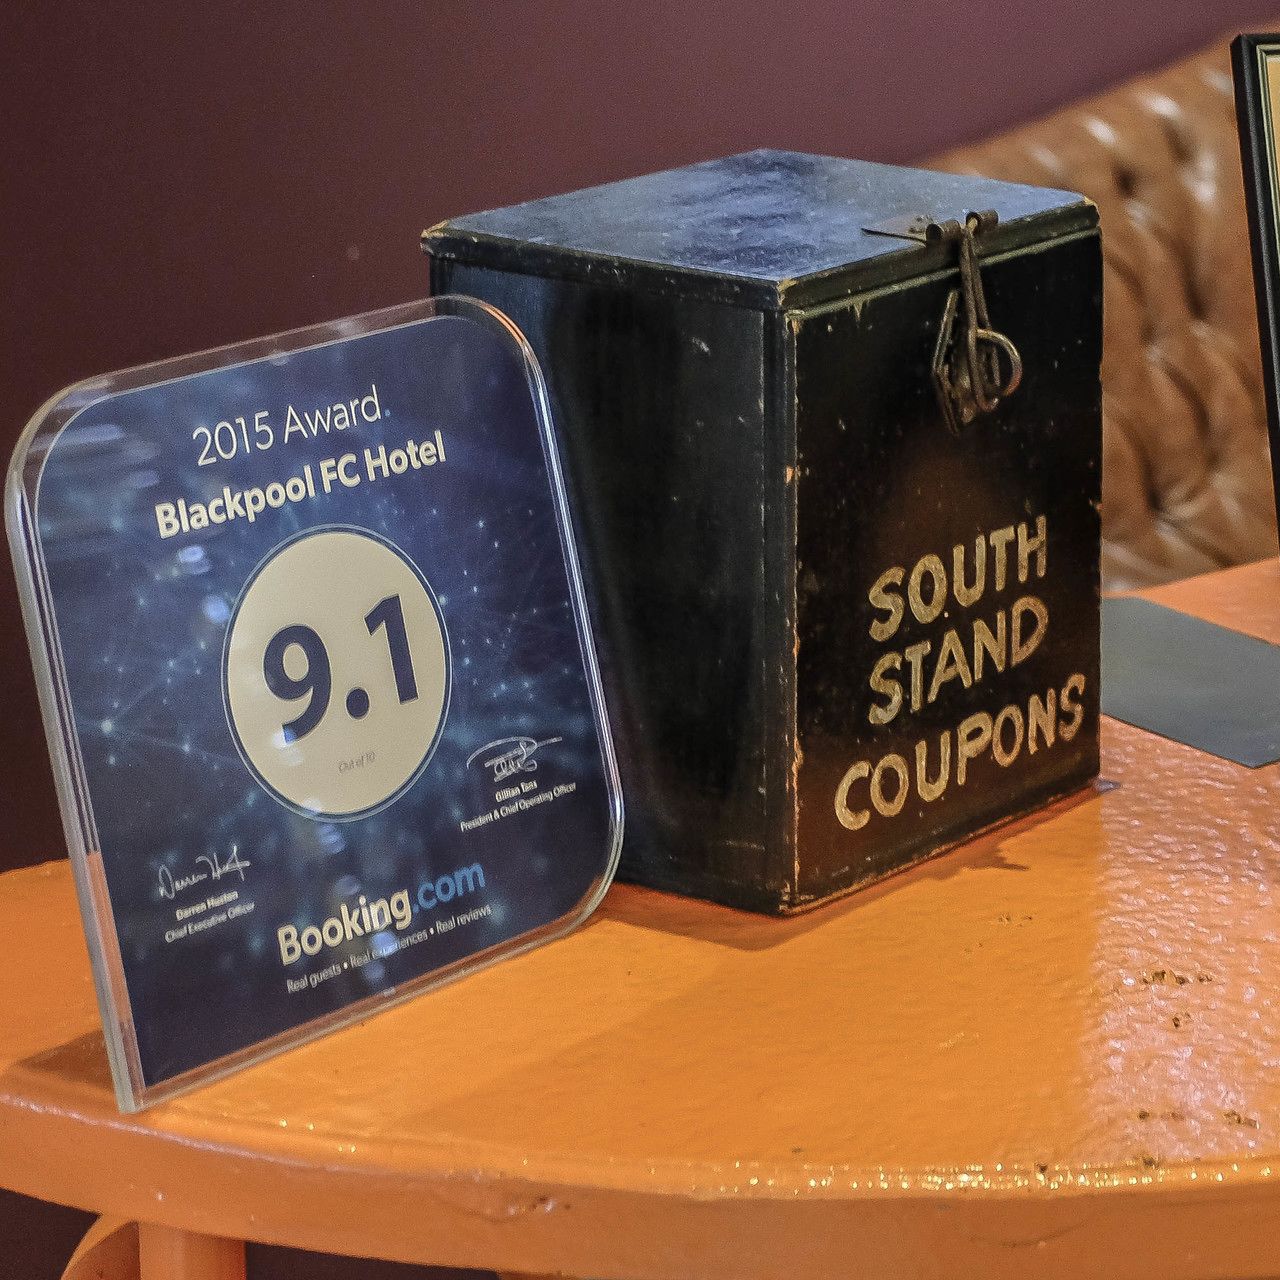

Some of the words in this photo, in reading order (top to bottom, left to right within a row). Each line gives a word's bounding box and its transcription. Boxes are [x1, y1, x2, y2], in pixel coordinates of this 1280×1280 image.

[154, 464, 317, 540] Blackpool
[320, 452, 361, 494] FC
[364, 429, 447, 482] Hotel
[192, 410, 274, 466] 2015
[283, 384, 382, 444] Award
[868, 515, 1048, 643] SOUTH
[262, 593, 419, 745] 9.1
[868, 595, 1049, 724] STAND
[834, 673, 1086, 831] COUPONS
[276, 862, 487, 967] Booking.com
[286, 975, 309, 995] Real
[310, 963, 342, 988] guests
[350, 949, 372, 969] Real
[372, 928, 429, 959] eiences
[435, 915, 456, 936] Real
[457, 902, 493, 927] reviews
